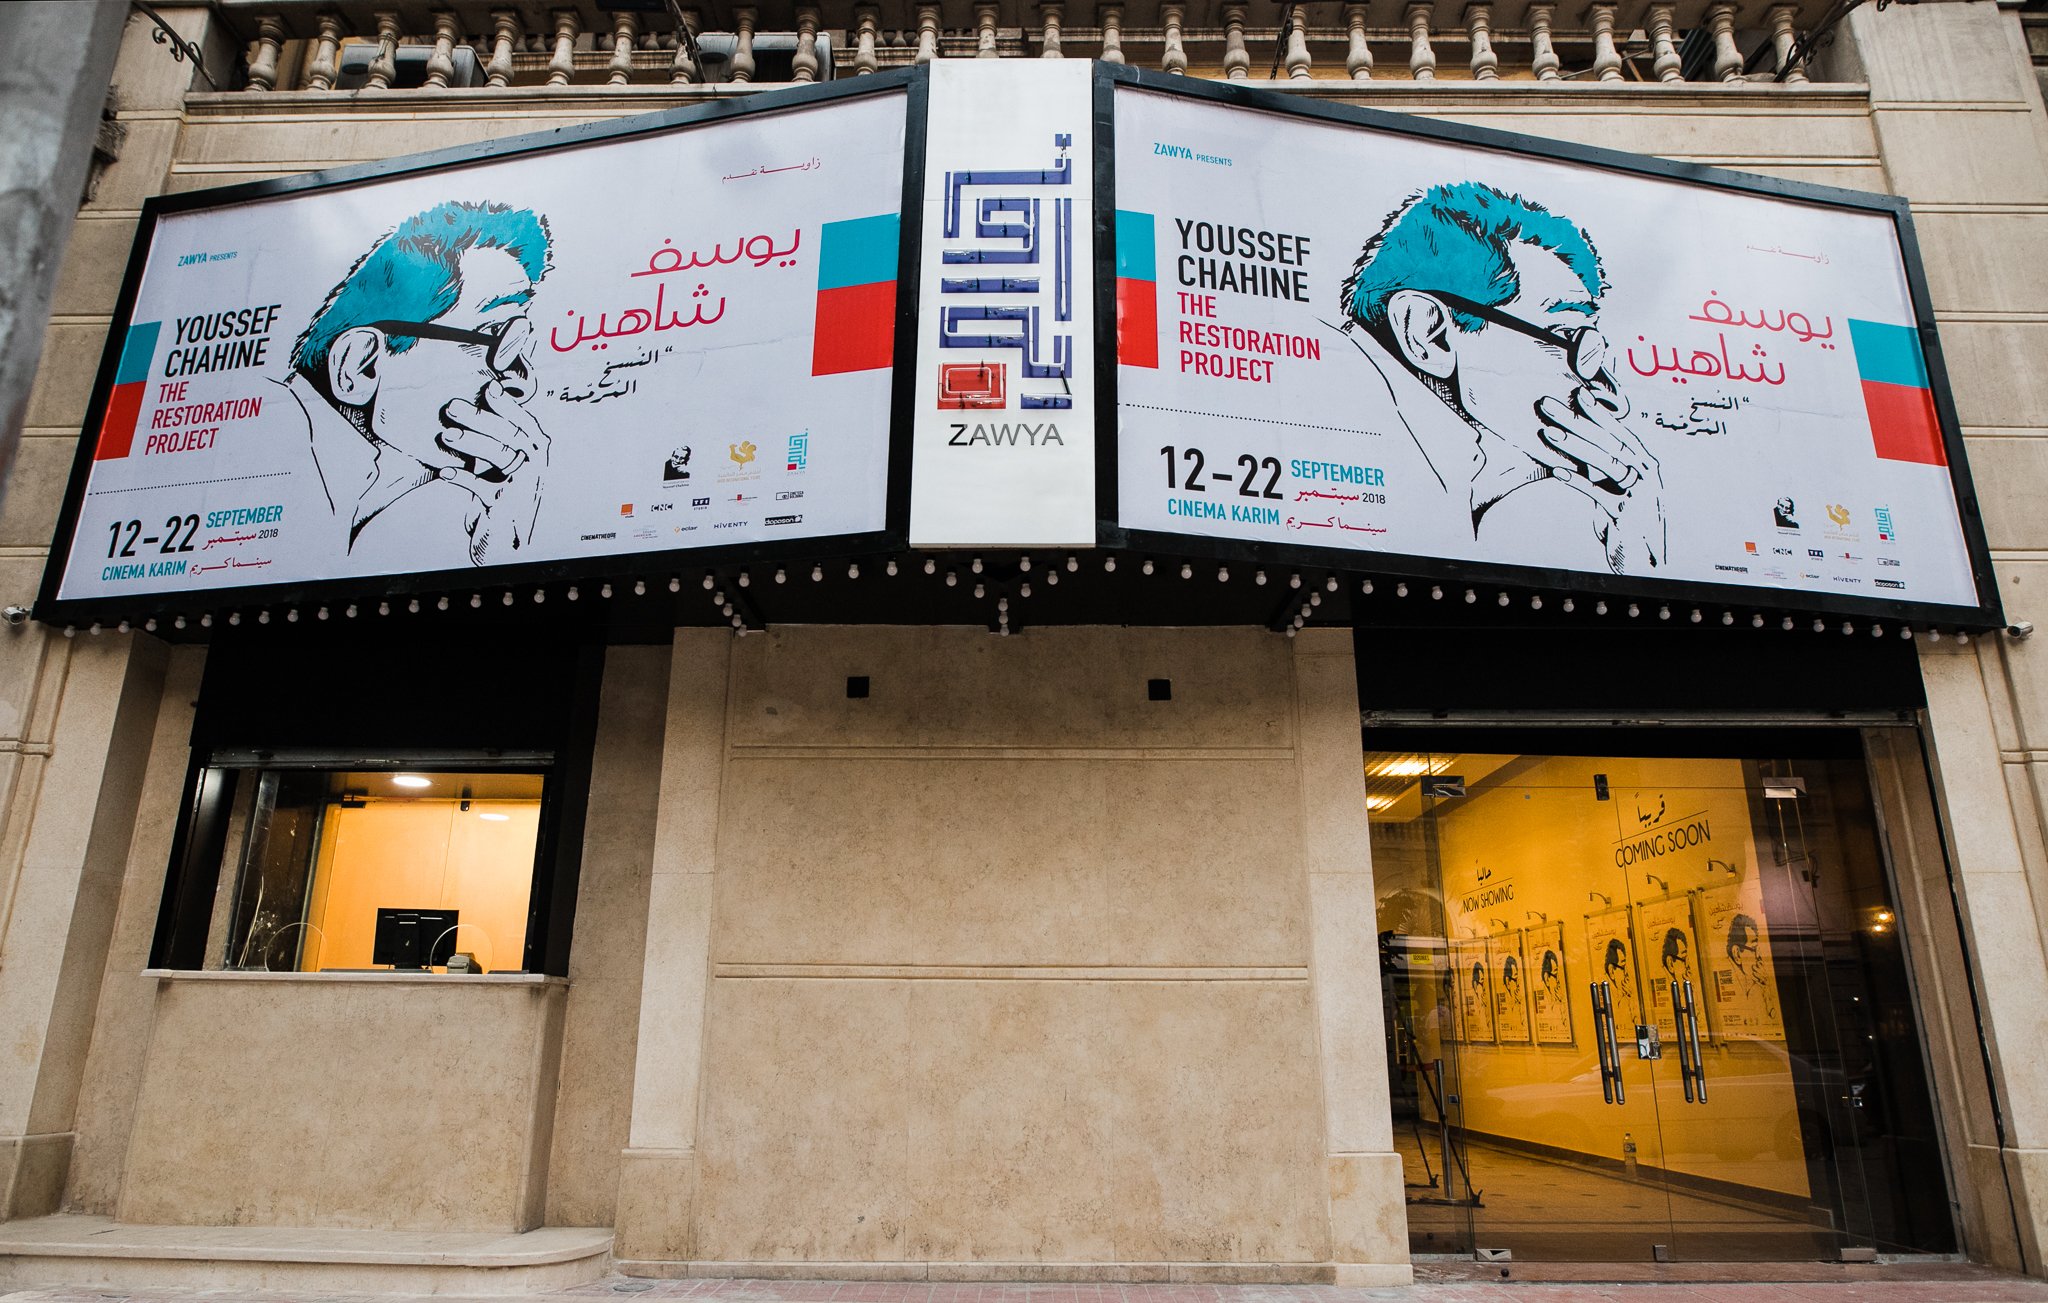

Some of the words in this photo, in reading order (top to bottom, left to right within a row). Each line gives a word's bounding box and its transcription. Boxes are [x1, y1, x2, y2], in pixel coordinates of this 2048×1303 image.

[1153, 142, 1193, 161] ZAWYA
[1196, 154, 1233, 167] PRESENTS
[631, 228, 801, 278] يوسف
[1174, 217, 1311, 266] YOUSSEF
[178, 251, 207, 267] ZAWYA
[209, 251, 238, 262] PRESENTS
[1177, 255, 1310, 303] CHAHINE
[550, 283, 726, 353] شاهين
[1177, 291, 1217, 319] THE
[1689, 289, 1835, 350] يوسف
[175, 303, 282, 345] YOUSSEF
[1179, 321, 1321, 361] RESTORATION
[164, 337, 271, 378] CHAHINE
[1180, 350, 1275, 384] PROJECT
[1627, 333, 1786, 385] شاهين
[158, 381, 189, 404] THE
[151, 397, 263, 430] RESTORATION
[144, 428, 219, 455] PROJECT
[948, 423, 1065, 447] ZAWYA
[1291, 459, 1385, 487] SEPTEMBER
[1294, 487, 1360, 505] سبتمبر
[1362, 493, 1386, 504] 2018
[206, 505, 283, 528] SEPTEMBER
[1167, 499, 1226, 521] CINEMA
[1232, 505, 1280, 525] KARIM
[202, 531, 257, 550] سبتمبر
[258, 529, 279, 539] 2018
[102, 563, 145, 581] CINEMA
[148, 560, 187, 577] KARIM
[1615, 835, 1665, 868] COMING
[1668, 820, 1711, 853] SOON
[1463, 897, 1480, 913] NOW
[1480, 884, 1514, 909] SHOWING
